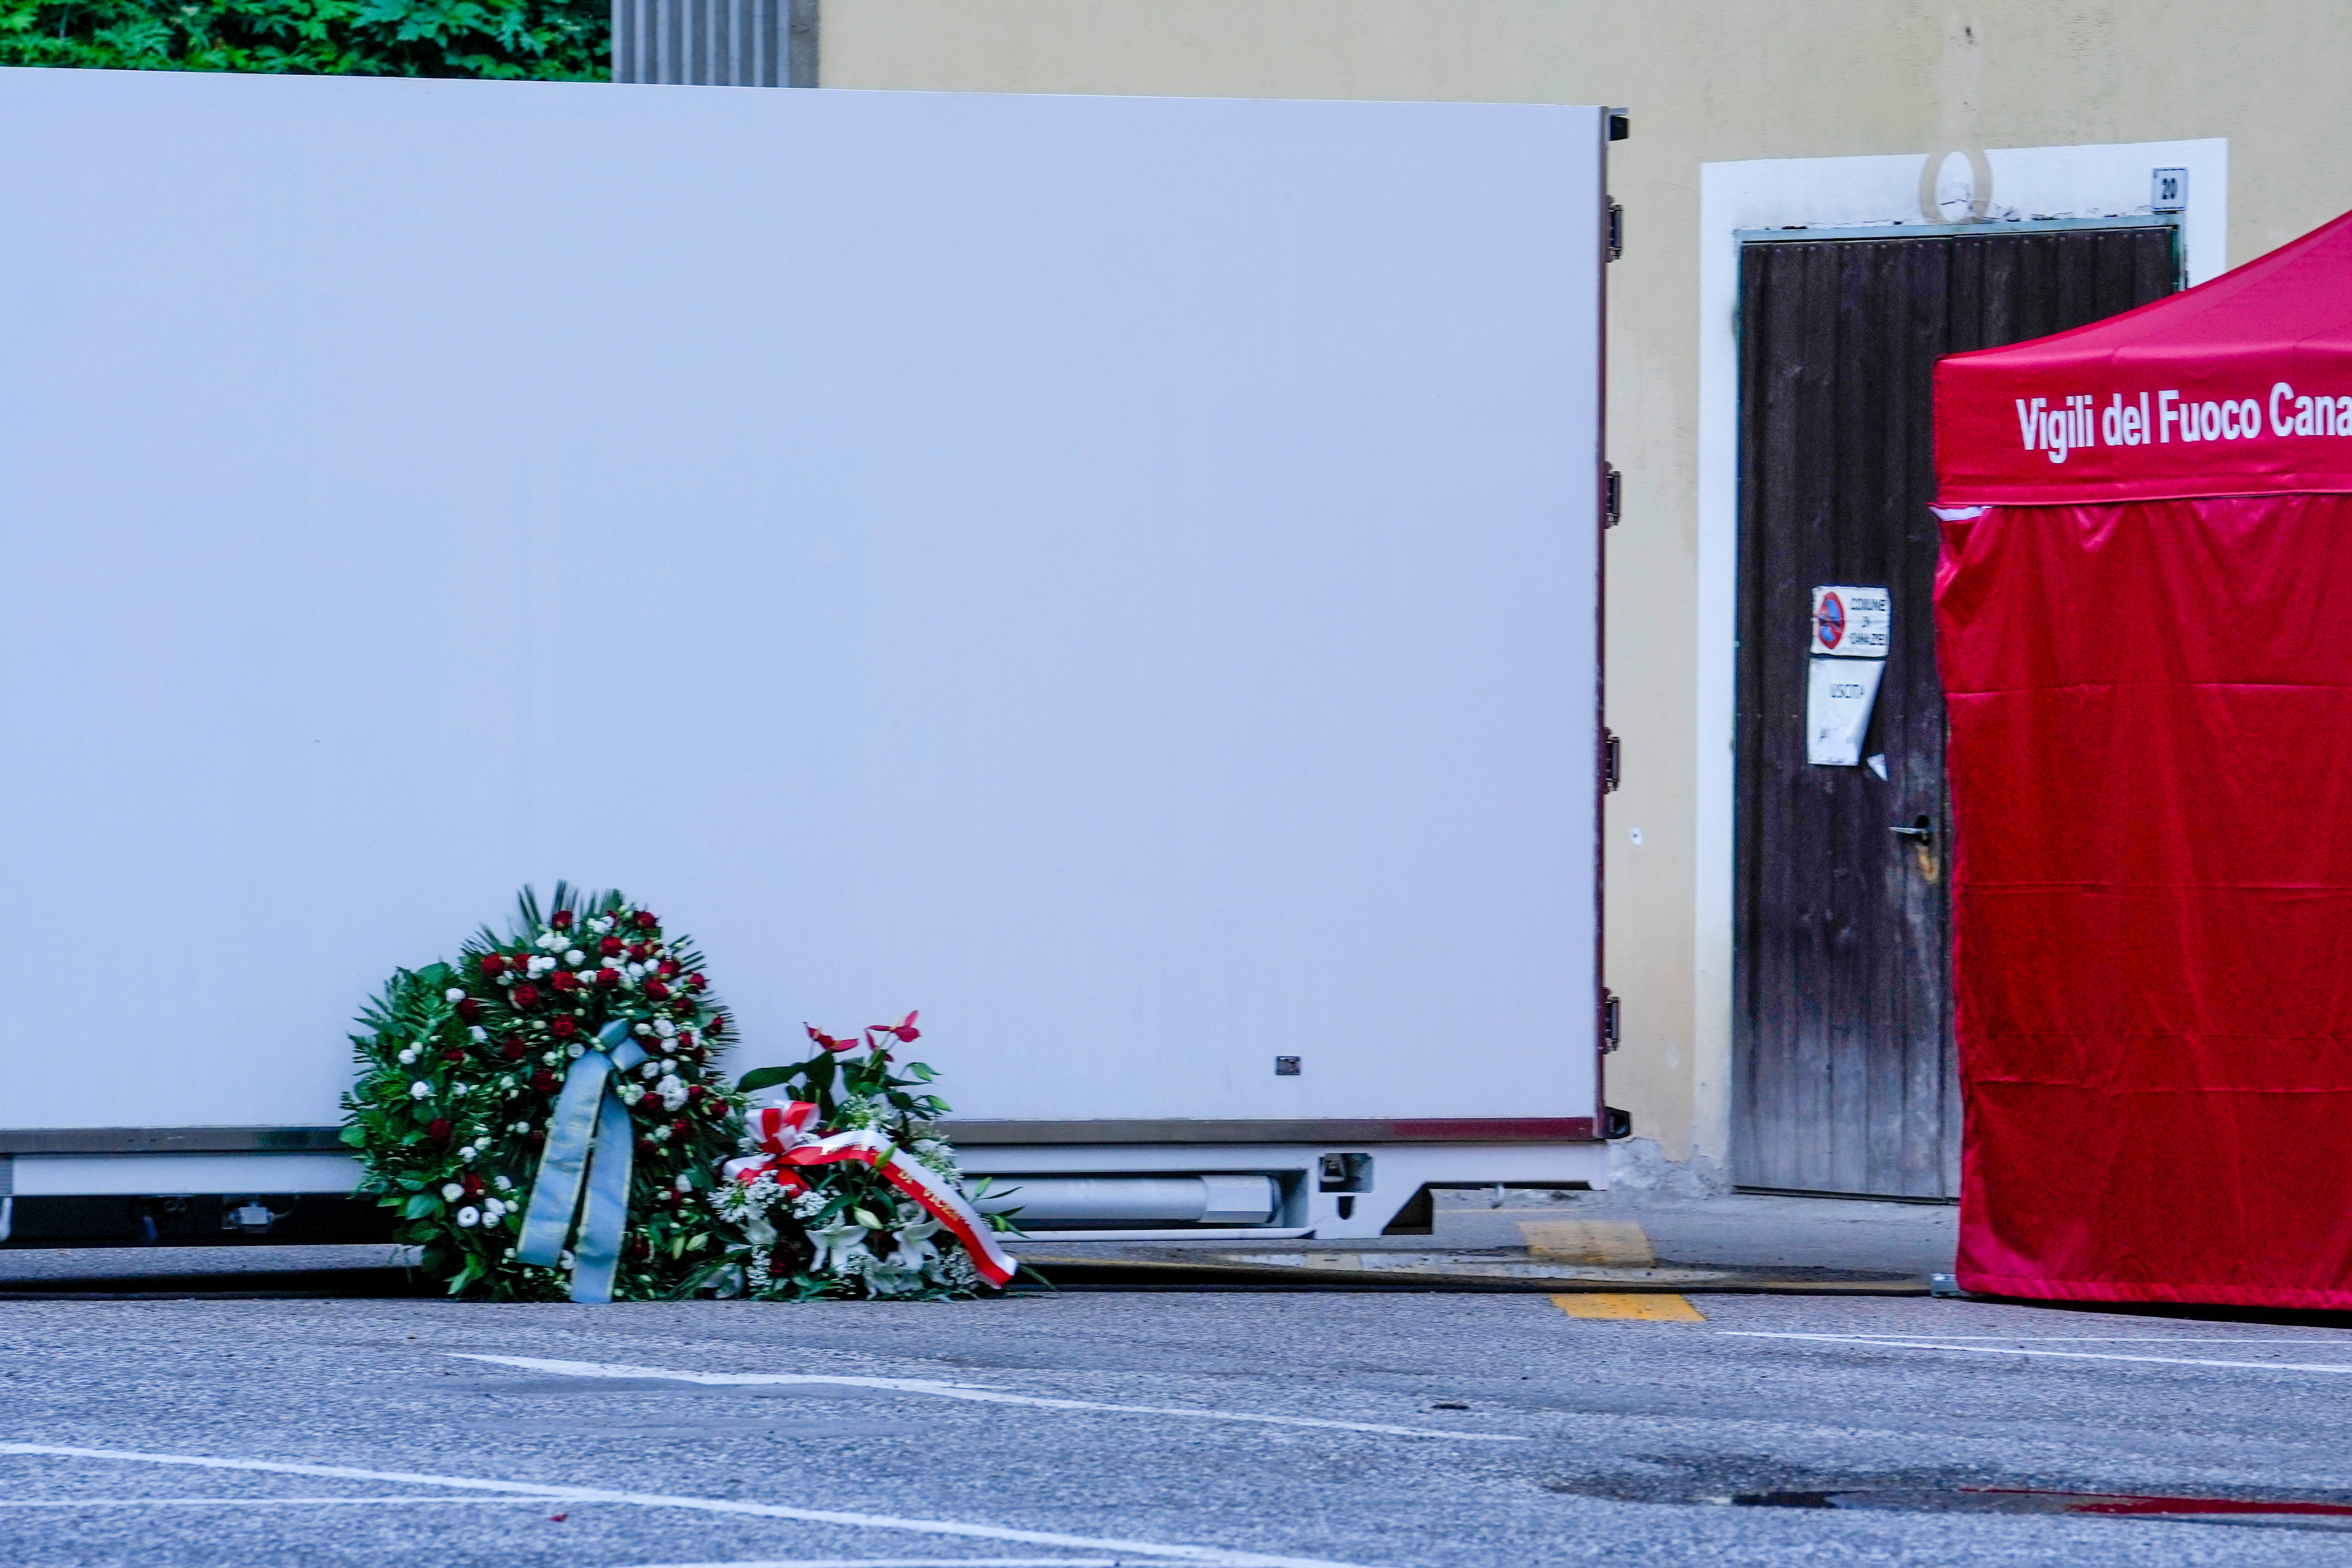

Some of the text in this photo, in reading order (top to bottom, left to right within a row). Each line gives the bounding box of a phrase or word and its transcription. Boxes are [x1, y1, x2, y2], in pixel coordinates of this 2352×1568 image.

[2161, 178, 2178, 200] 20
[2015, 395, 2094, 464] Vigili
[2102, 392, 2150, 446] del
[2158, 389, 2261, 443] Fuoco
[1849, 598, 1886, 611] COMUNE
[1829, 683, 1865, 699] USCITA
